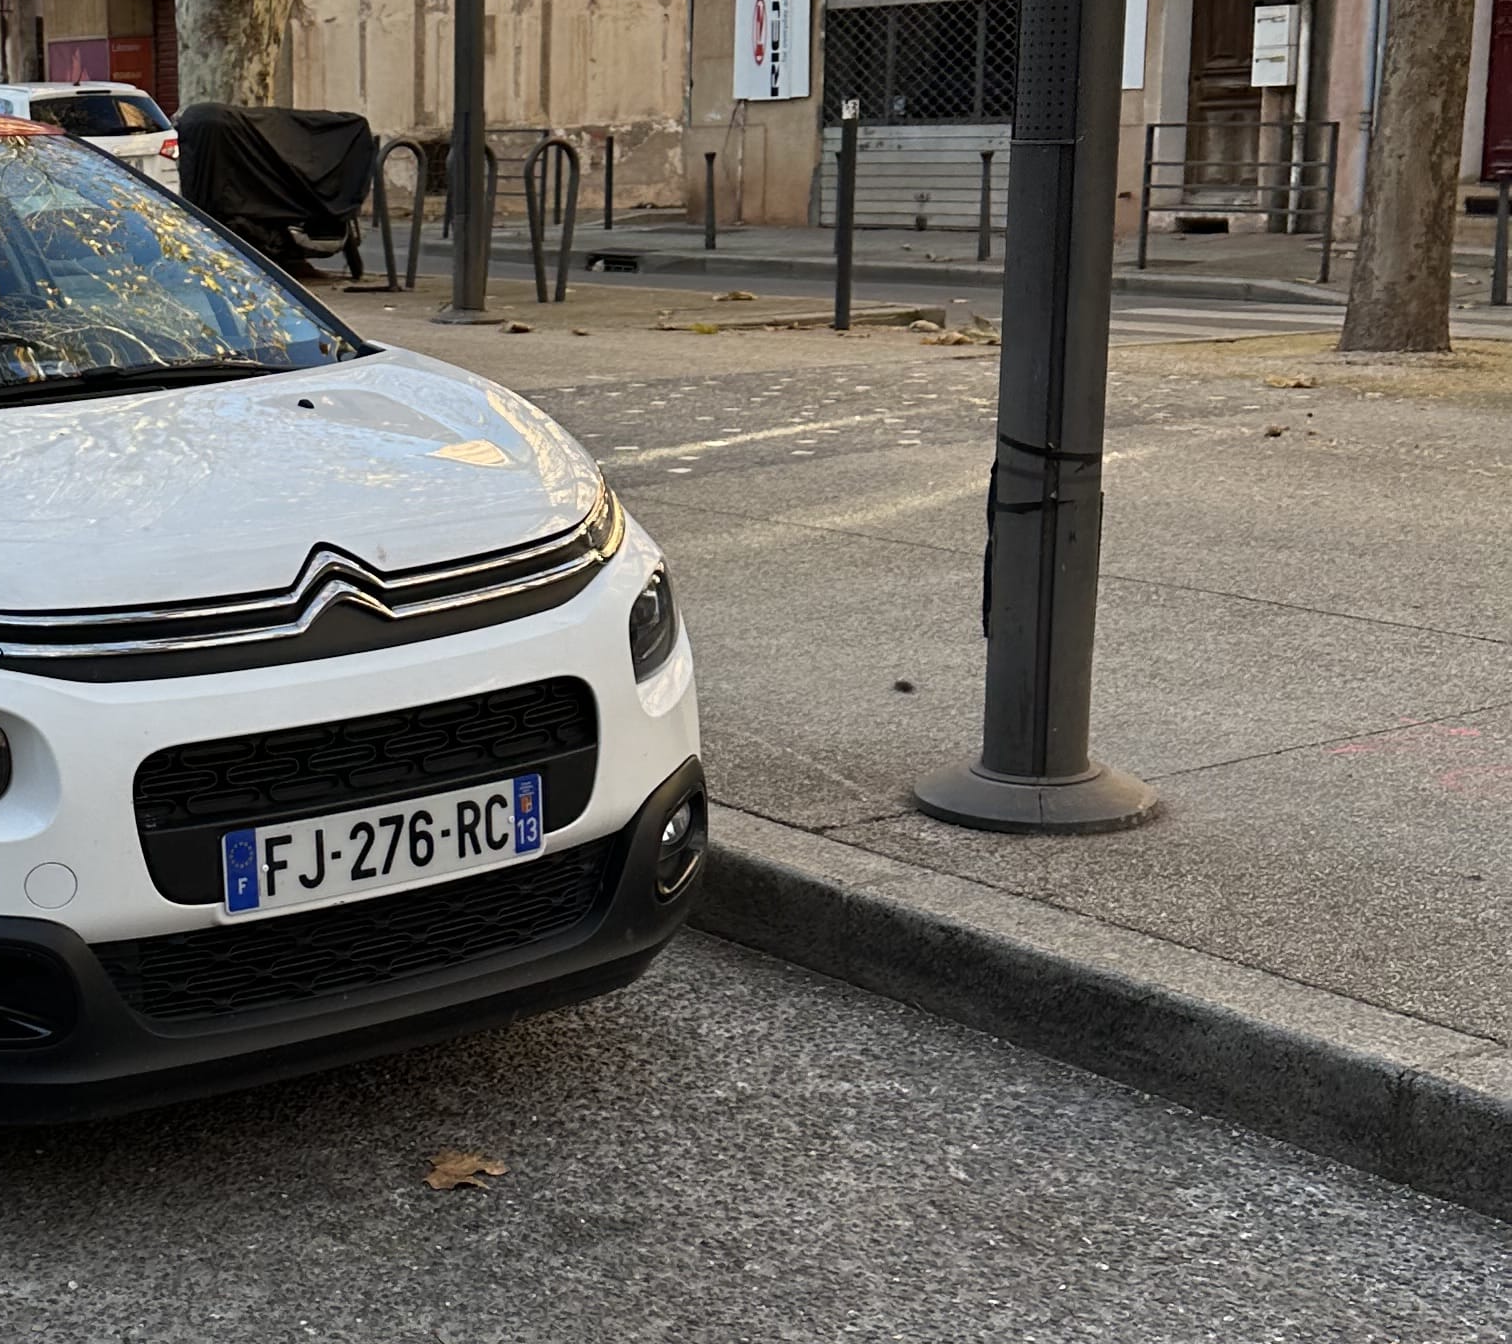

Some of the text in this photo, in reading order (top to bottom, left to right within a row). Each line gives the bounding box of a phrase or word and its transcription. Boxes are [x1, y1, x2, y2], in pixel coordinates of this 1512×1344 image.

[264, 793, 510, 897] FJ-276-RC
[516, 816, 538, 845] 13
[238, 877, 249, 895] F
